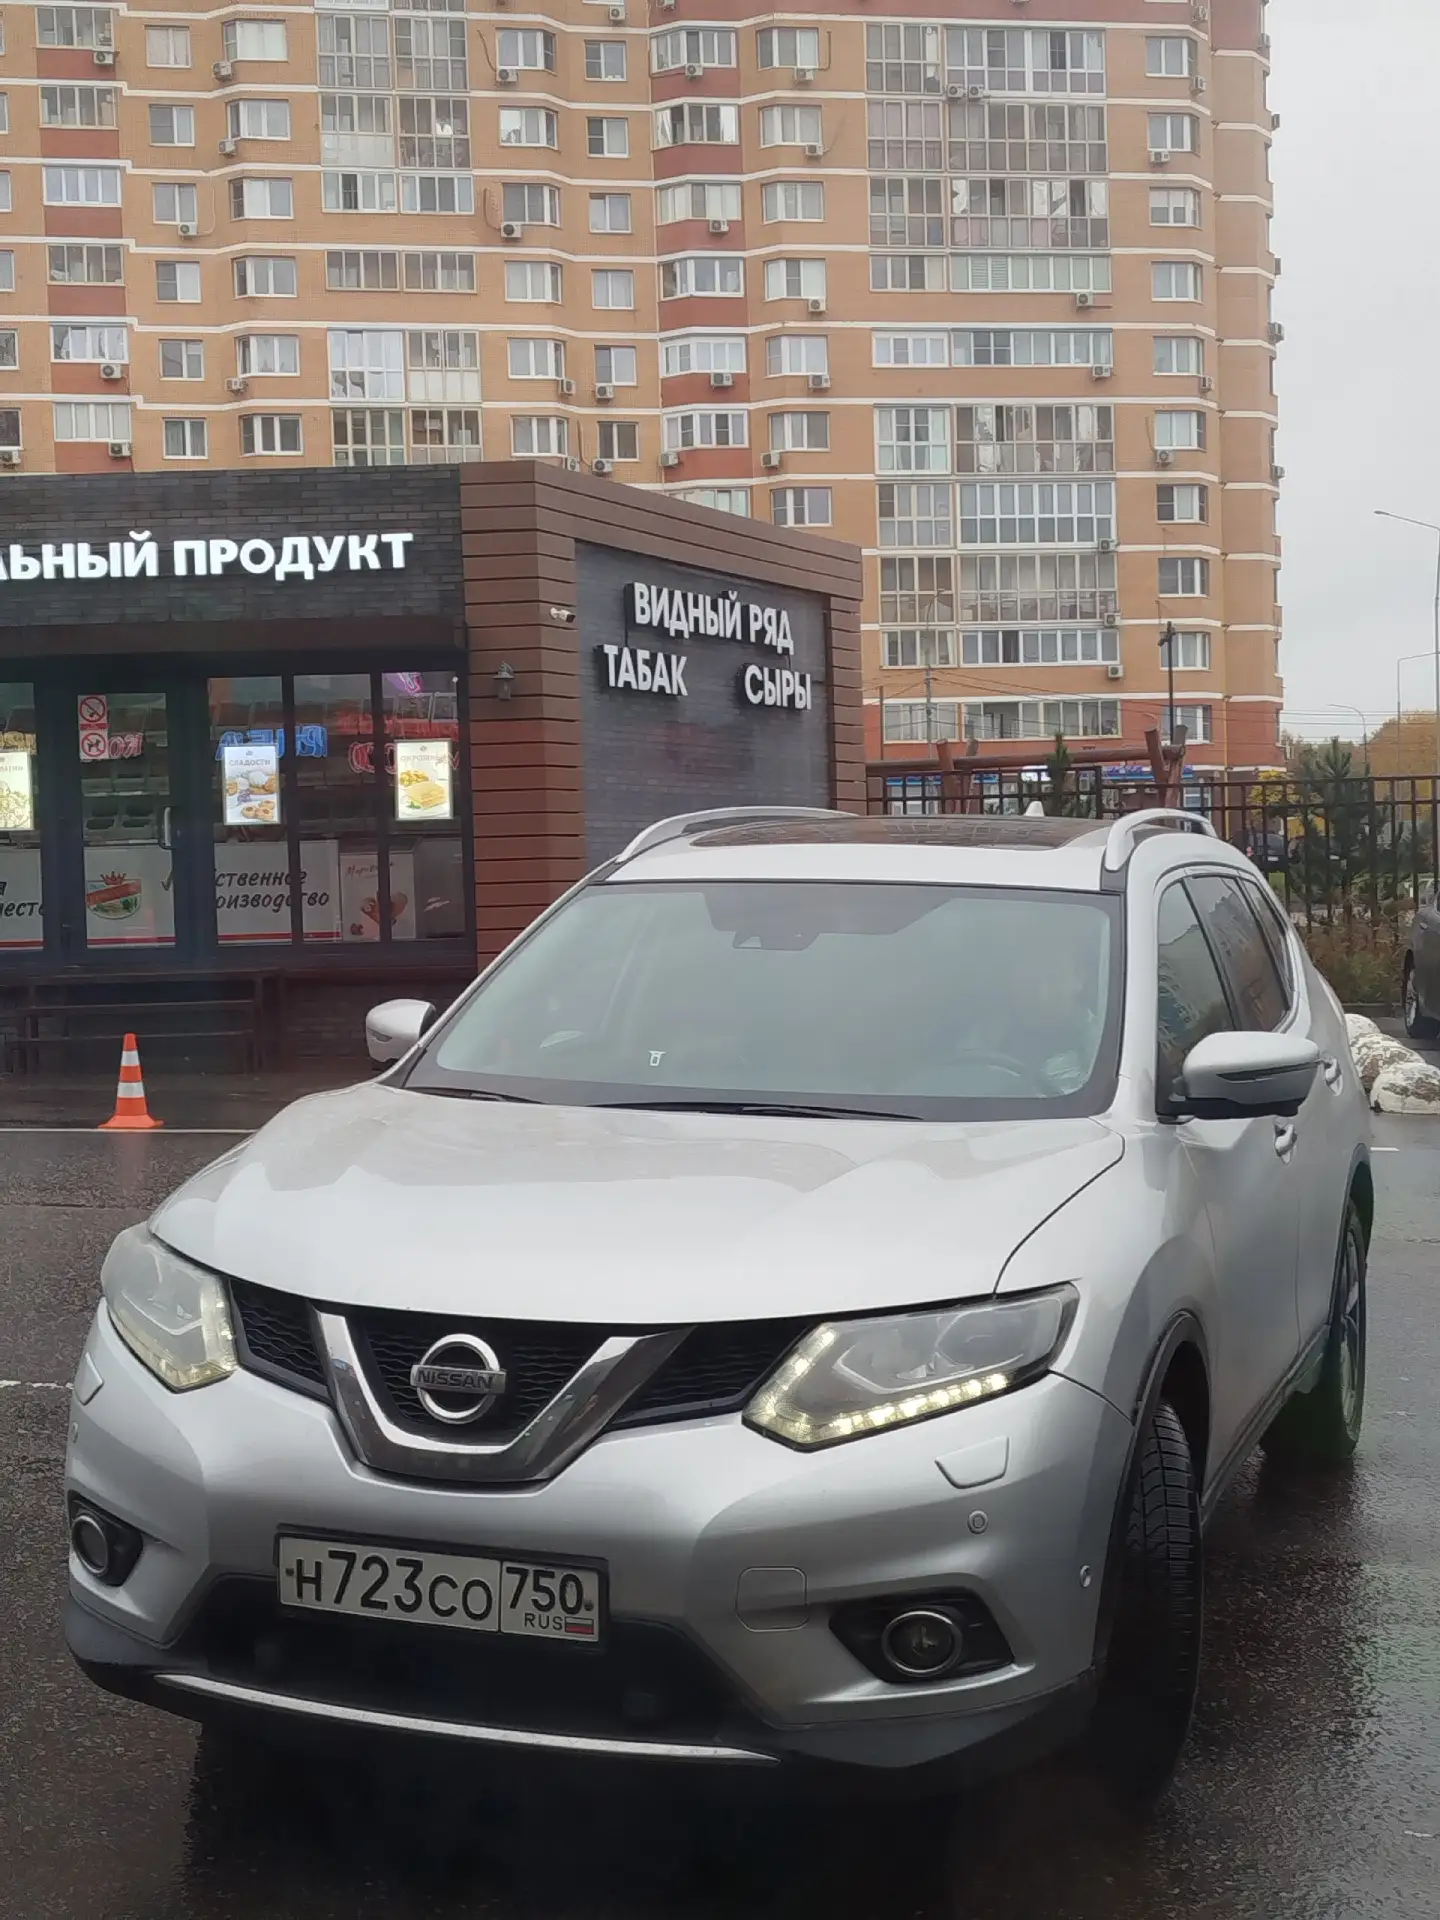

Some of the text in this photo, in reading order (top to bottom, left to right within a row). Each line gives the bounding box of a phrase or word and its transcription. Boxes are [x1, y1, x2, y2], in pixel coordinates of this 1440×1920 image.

[0, 530, 414, 581] ЬНЫЙ ПРОДУКТ
[634, 581, 795, 656] ВИДНЫЙ РЯД
[603, 644, 689, 697] ТАБАК
[744, 664, 812, 710] СЫРЫ
[228, 758, 271, 767] СЛАДОСТИ
[215, 870, 308, 887] ственное
[417, 1369, 494, 1389] NISSAN
[505, 1566, 585, 1616] 750
[523, 1612, 564, 1631] RUS
